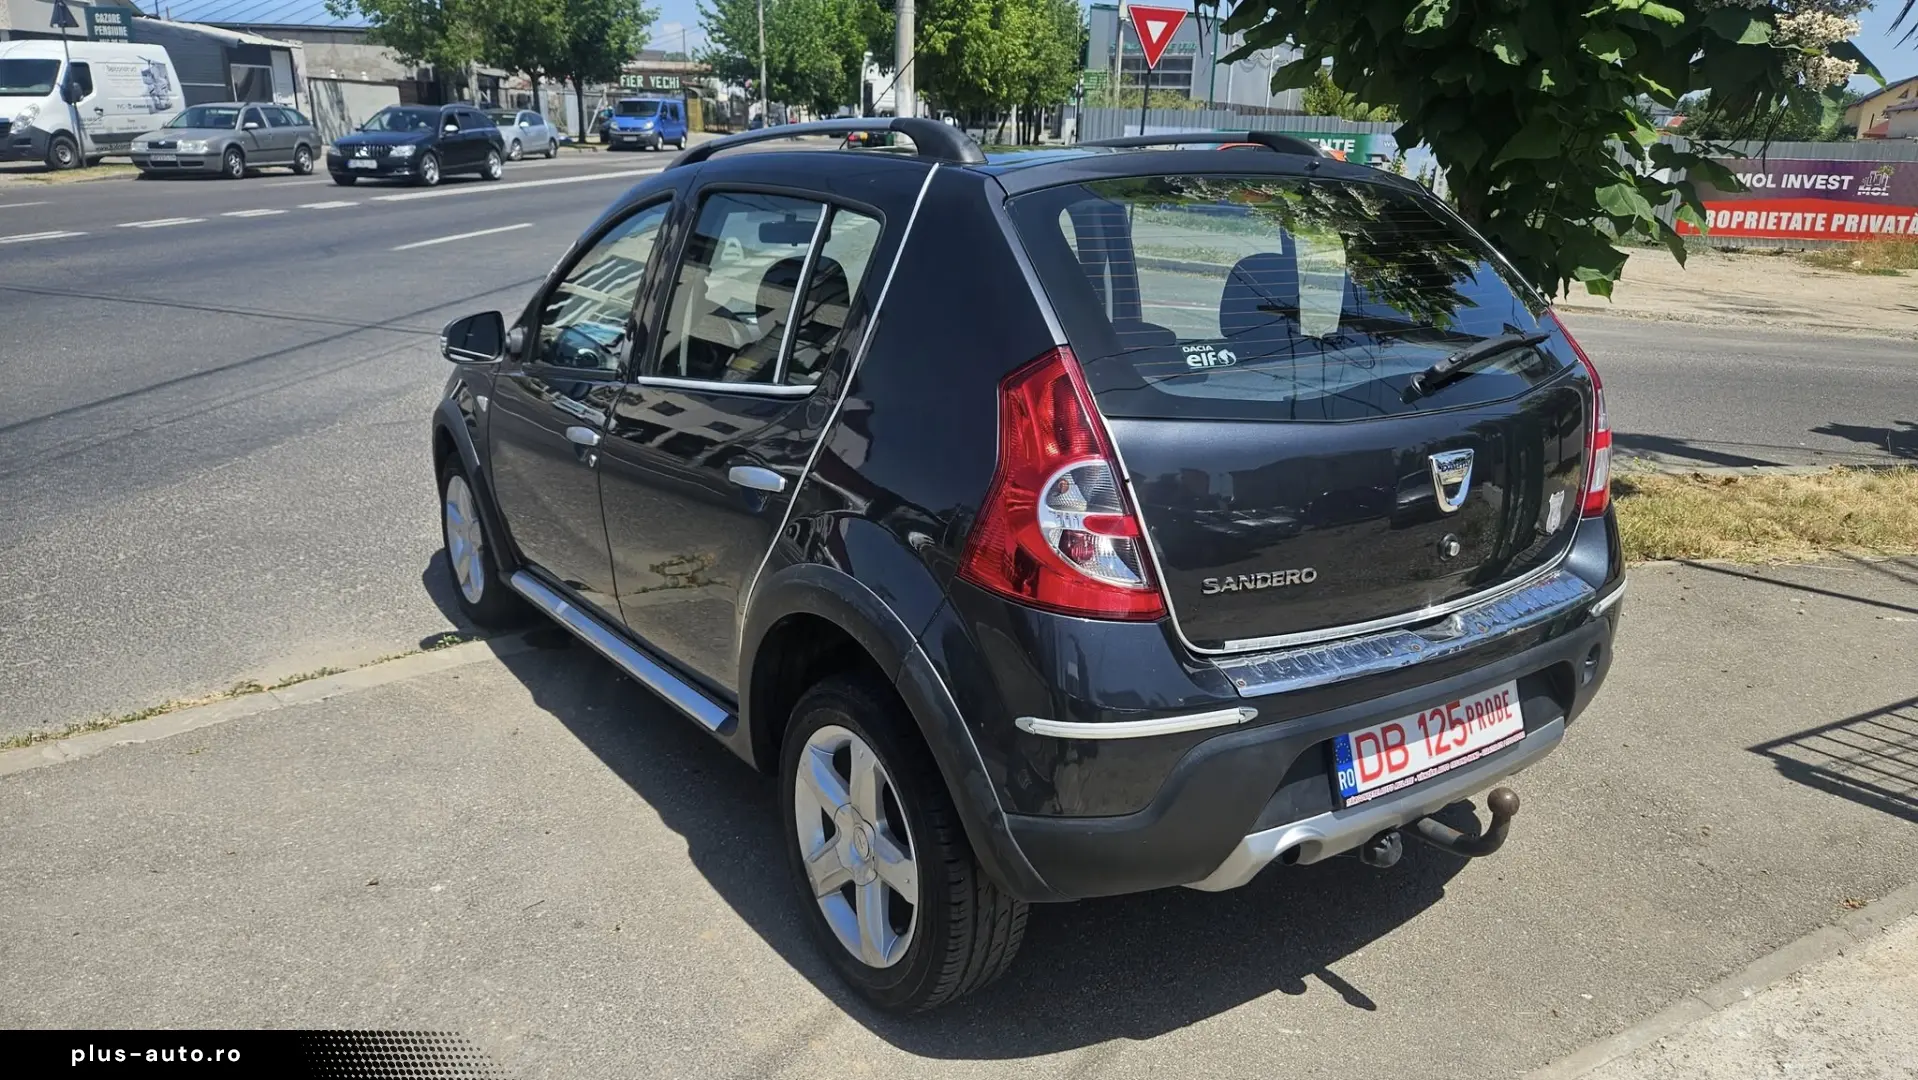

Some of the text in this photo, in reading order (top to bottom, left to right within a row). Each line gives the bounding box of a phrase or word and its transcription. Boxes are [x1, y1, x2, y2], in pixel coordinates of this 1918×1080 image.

[95, 12, 121, 24] CAZARE
[94, 25, 128, 37] PENSIUNE
[1309, 138, 1356, 154] NTE
[1781, 173, 1854, 190] INVEST
[1688, 209, 1828, 232] ROPRIETATE
[1182, 345, 1214, 353] DACIA
[1186, 351, 1217, 367] elf
[1201, 567, 1318, 595] SANDERO
[1354, 689, 1513, 784] DB 125 PROBE
[1338, 768, 1356, 791] RO
